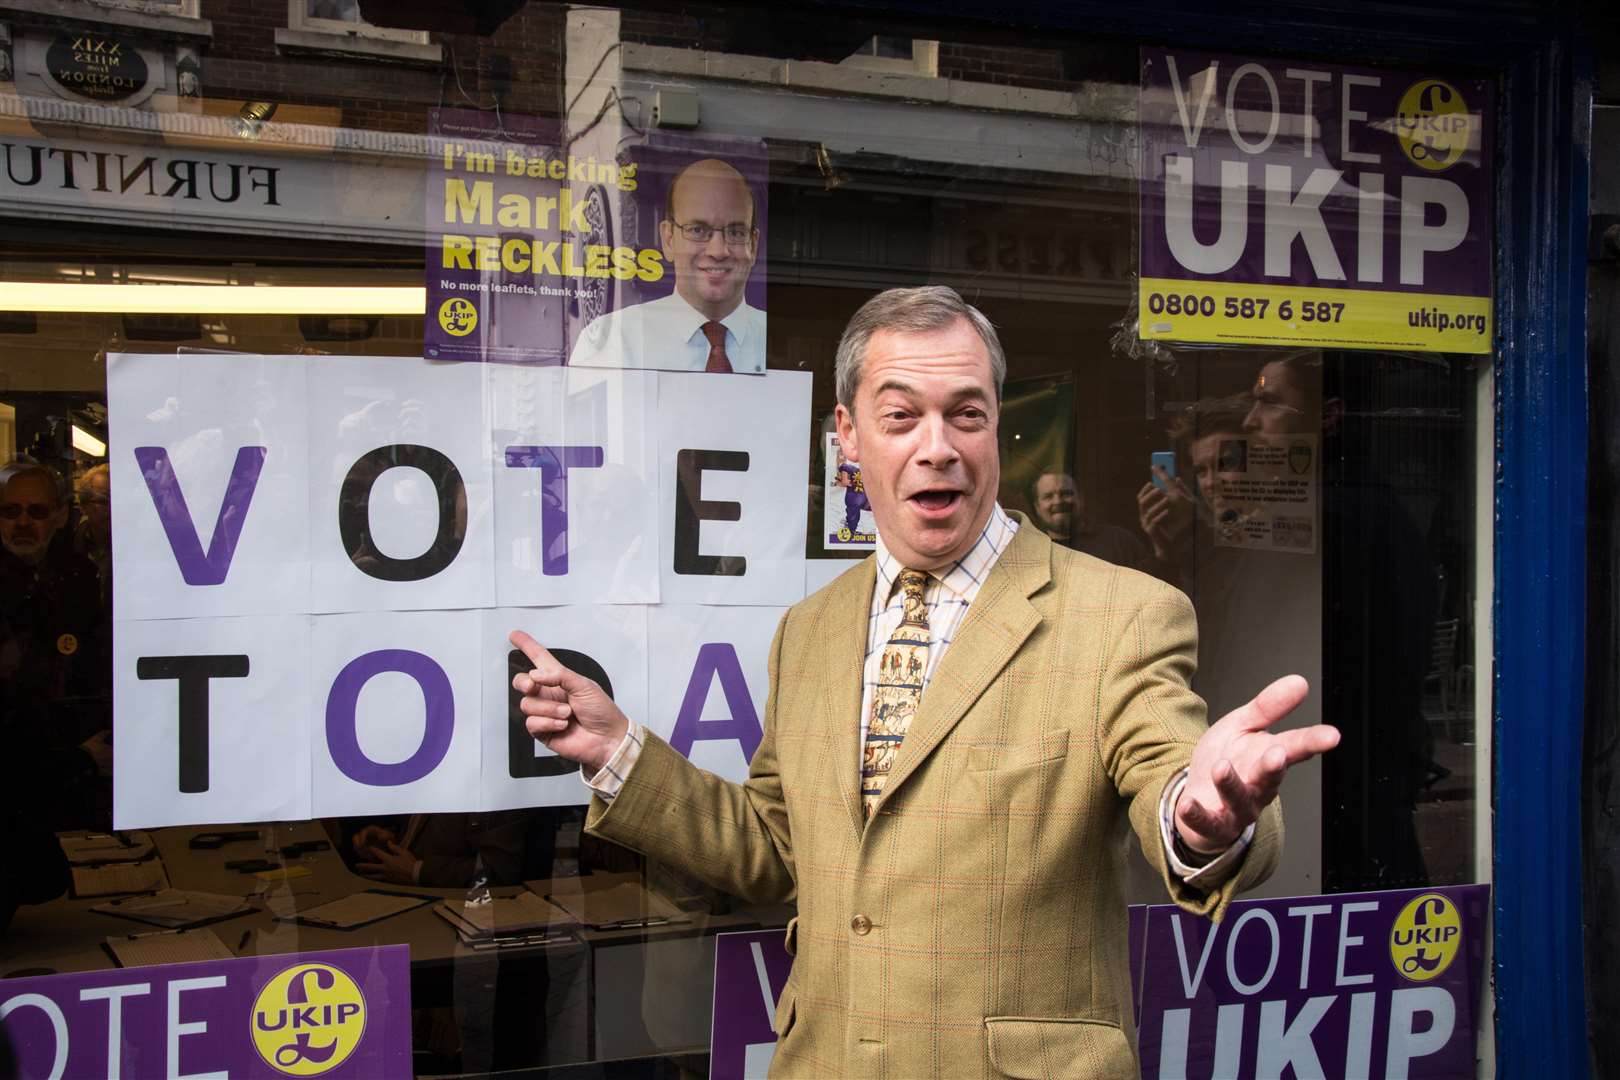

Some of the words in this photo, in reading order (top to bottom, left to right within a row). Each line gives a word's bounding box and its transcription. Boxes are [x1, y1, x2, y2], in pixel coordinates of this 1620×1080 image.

[1165, 55, 1381, 164] VOTE
[1400, 111, 1468, 134] UKIP
[444, 144, 495, 174] I'm
[506, 151, 639, 192] backing
[444, 178, 592, 234] Mark
[1164, 155, 1470, 286] UKIP
[441, 235, 665, 283] RECKLESS
[440, 279, 456, 290] No
[459, 282, 488, 292] more
[491, 283, 537, 297] leaflets,
[540, 286, 571, 297] thank
[574, 288, 597, 299] you!
[1148, 293, 1216, 317] 0800
[1224, 296, 1270, 320] 587
[1278, 300, 1293, 321] 6
[1300, 301, 1345, 323] 587
[444, 311, 473, 320] UKIP
[1408, 307, 1486, 335] ukip.org
[134, 444, 750, 586] VOTE
[1171, 901, 1379, 999] VOTE
[1394, 925, 1458, 946] UKIP
[257, 1002, 360, 1031] UKIP
[1159, 986, 1456, 1080] UKIP
